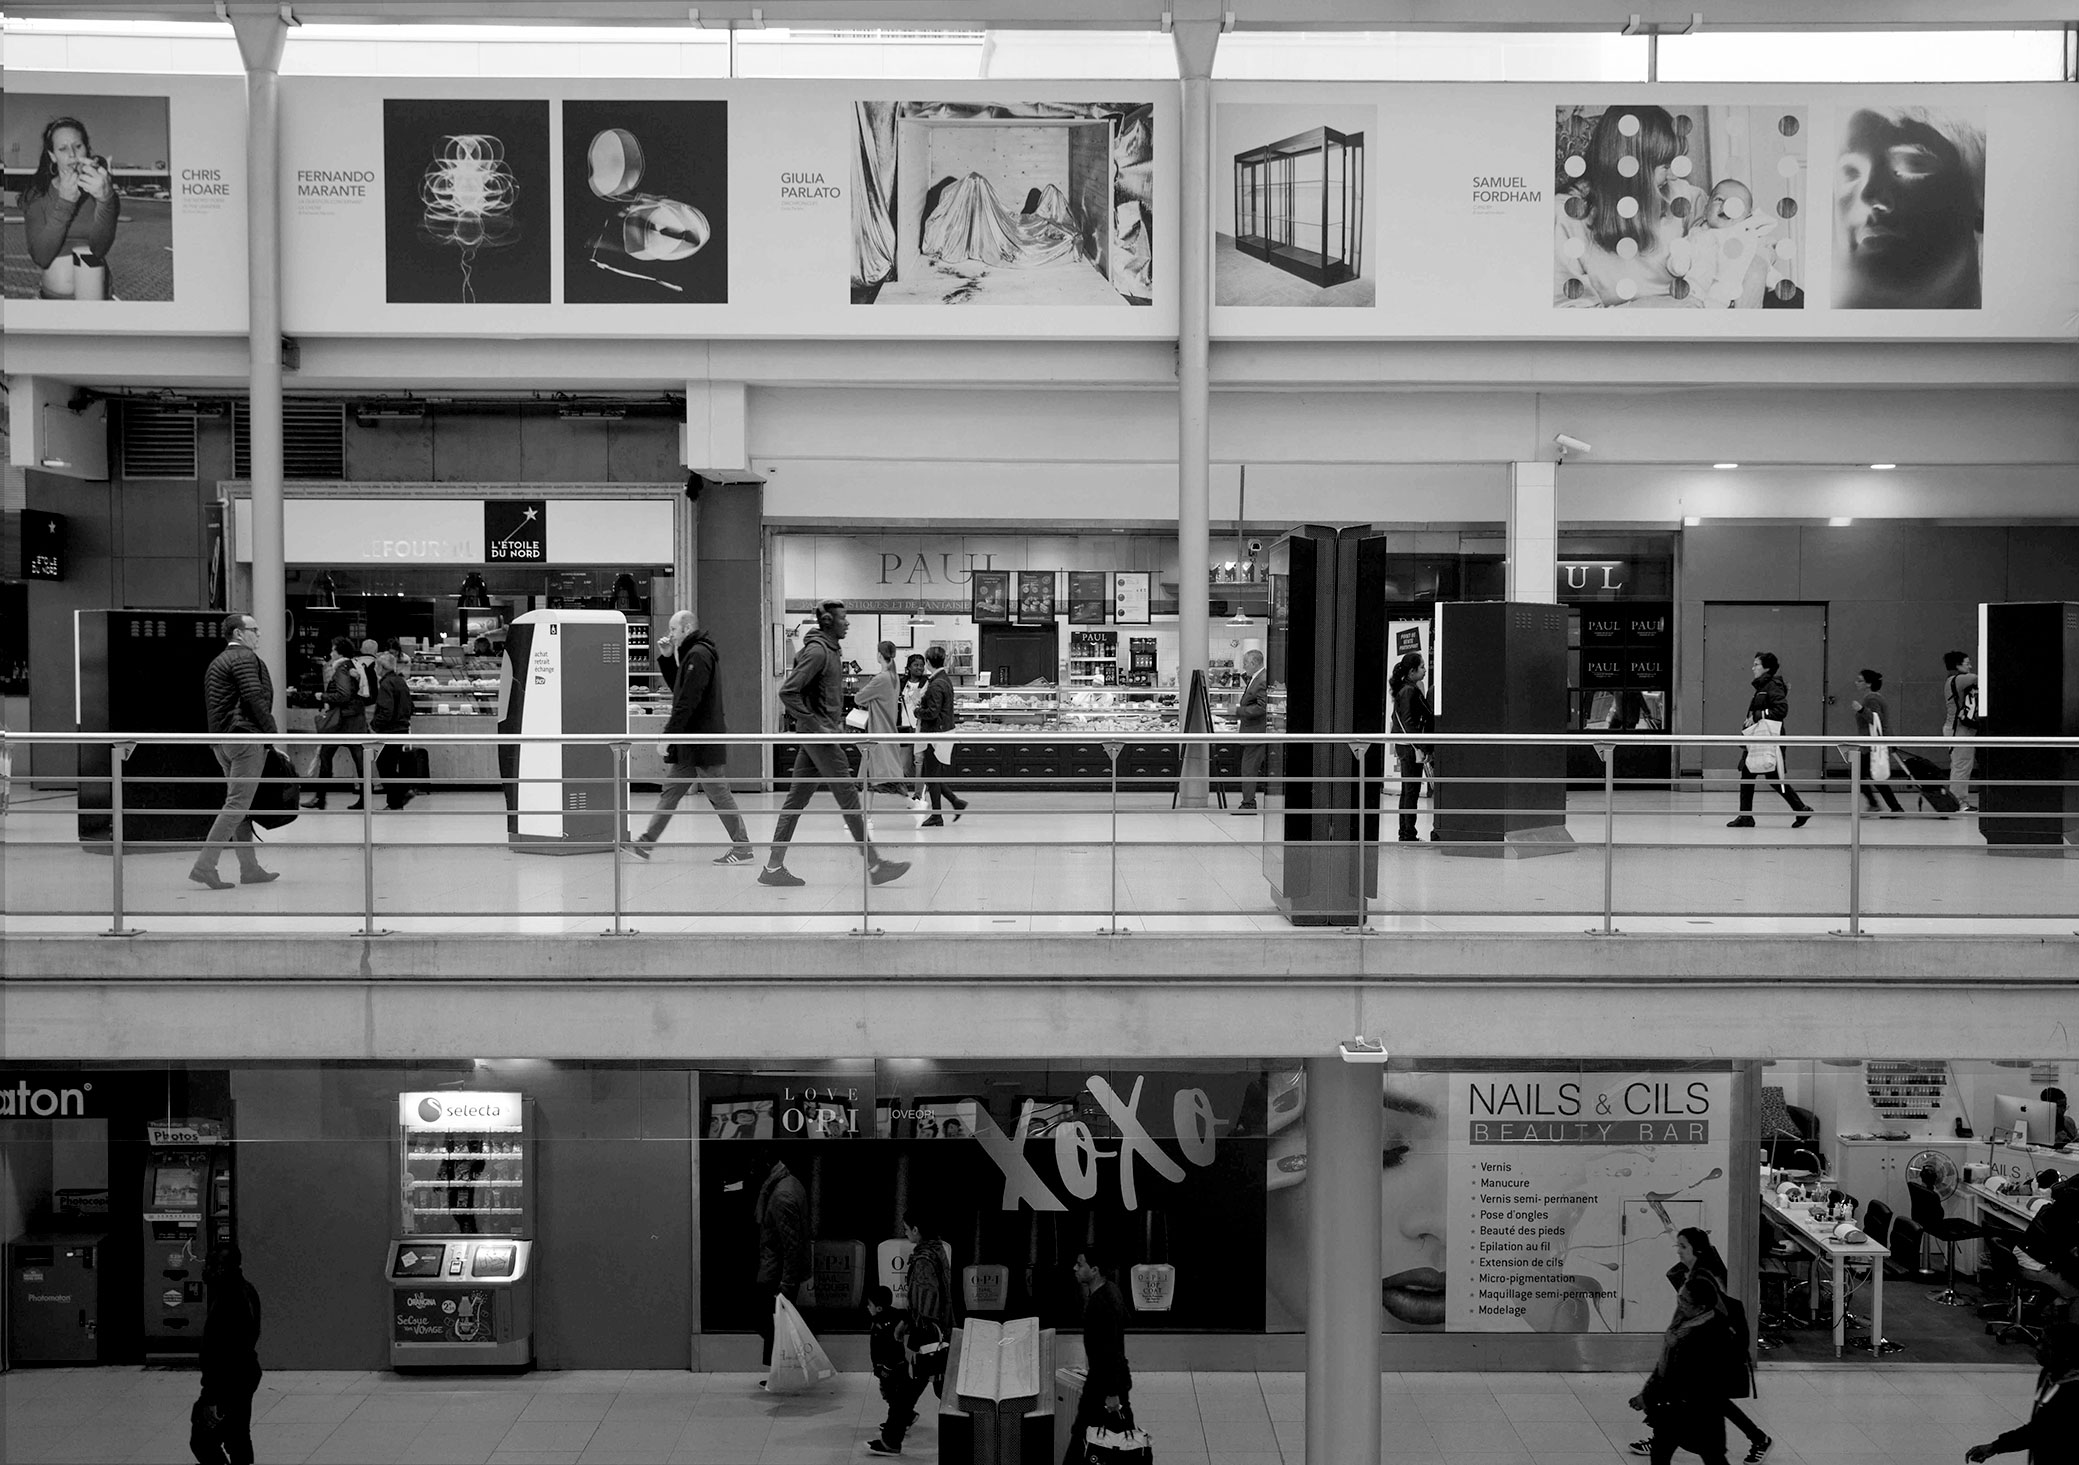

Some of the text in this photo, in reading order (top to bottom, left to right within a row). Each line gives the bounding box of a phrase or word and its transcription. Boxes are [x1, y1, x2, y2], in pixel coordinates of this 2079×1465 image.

[182, 169, 221, 181] CHRIS
[297, 170, 375, 183] FERNANDO
[781, 172, 825, 184] GIULIA
[1473, 176, 1527, 188] SAMUEL
[182, 183, 230, 196] HOARE
[298, 185, 366, 197] MARANTE
[781, 187, 841, 198] PARLATO
[1473, 191, 1542, 202] FORDHAM
[491, 549, 541, 558] DU NORD
[1588, 621, 1620, 631] PAUL
[1631, 621, 1662, 631] PAUL
[1082, 633, 1107, 642] PAUL
[1588, 662, 1620, 672] PAUL
[1631, 662, 1663, 672] PAUL
[784, 1087, 859, 1101] LOVE
[1469, 1081, 1710, 1116] NAILS & CILS
[446, 1104, 500, 1117] selecta
[1474, 1122, 1705, 1142] BEAUTY BAR
[1480, 1162, 1512, 1172] Vernis
[1480, 1178, 1530, 1188] Manucure
[1480, 1194, 1598, 1206] Vernis semi- permanent
[1480, 1210, 1549, 1222] Pose d'ongles
[1480, 1226, 1566, 1238] Beauté des pieds
[1479, 1241, 1551, 1253] Epilation au fil
[1479, 1257, 1565, 1268] Extension de cils
[1479, 1273, 1576, 1286] Micro-pigmentation
[1479, 1289, 1617, 1302] Maquillage semi-permanent
[1478, 1305, 1527, 1318] Modelage
